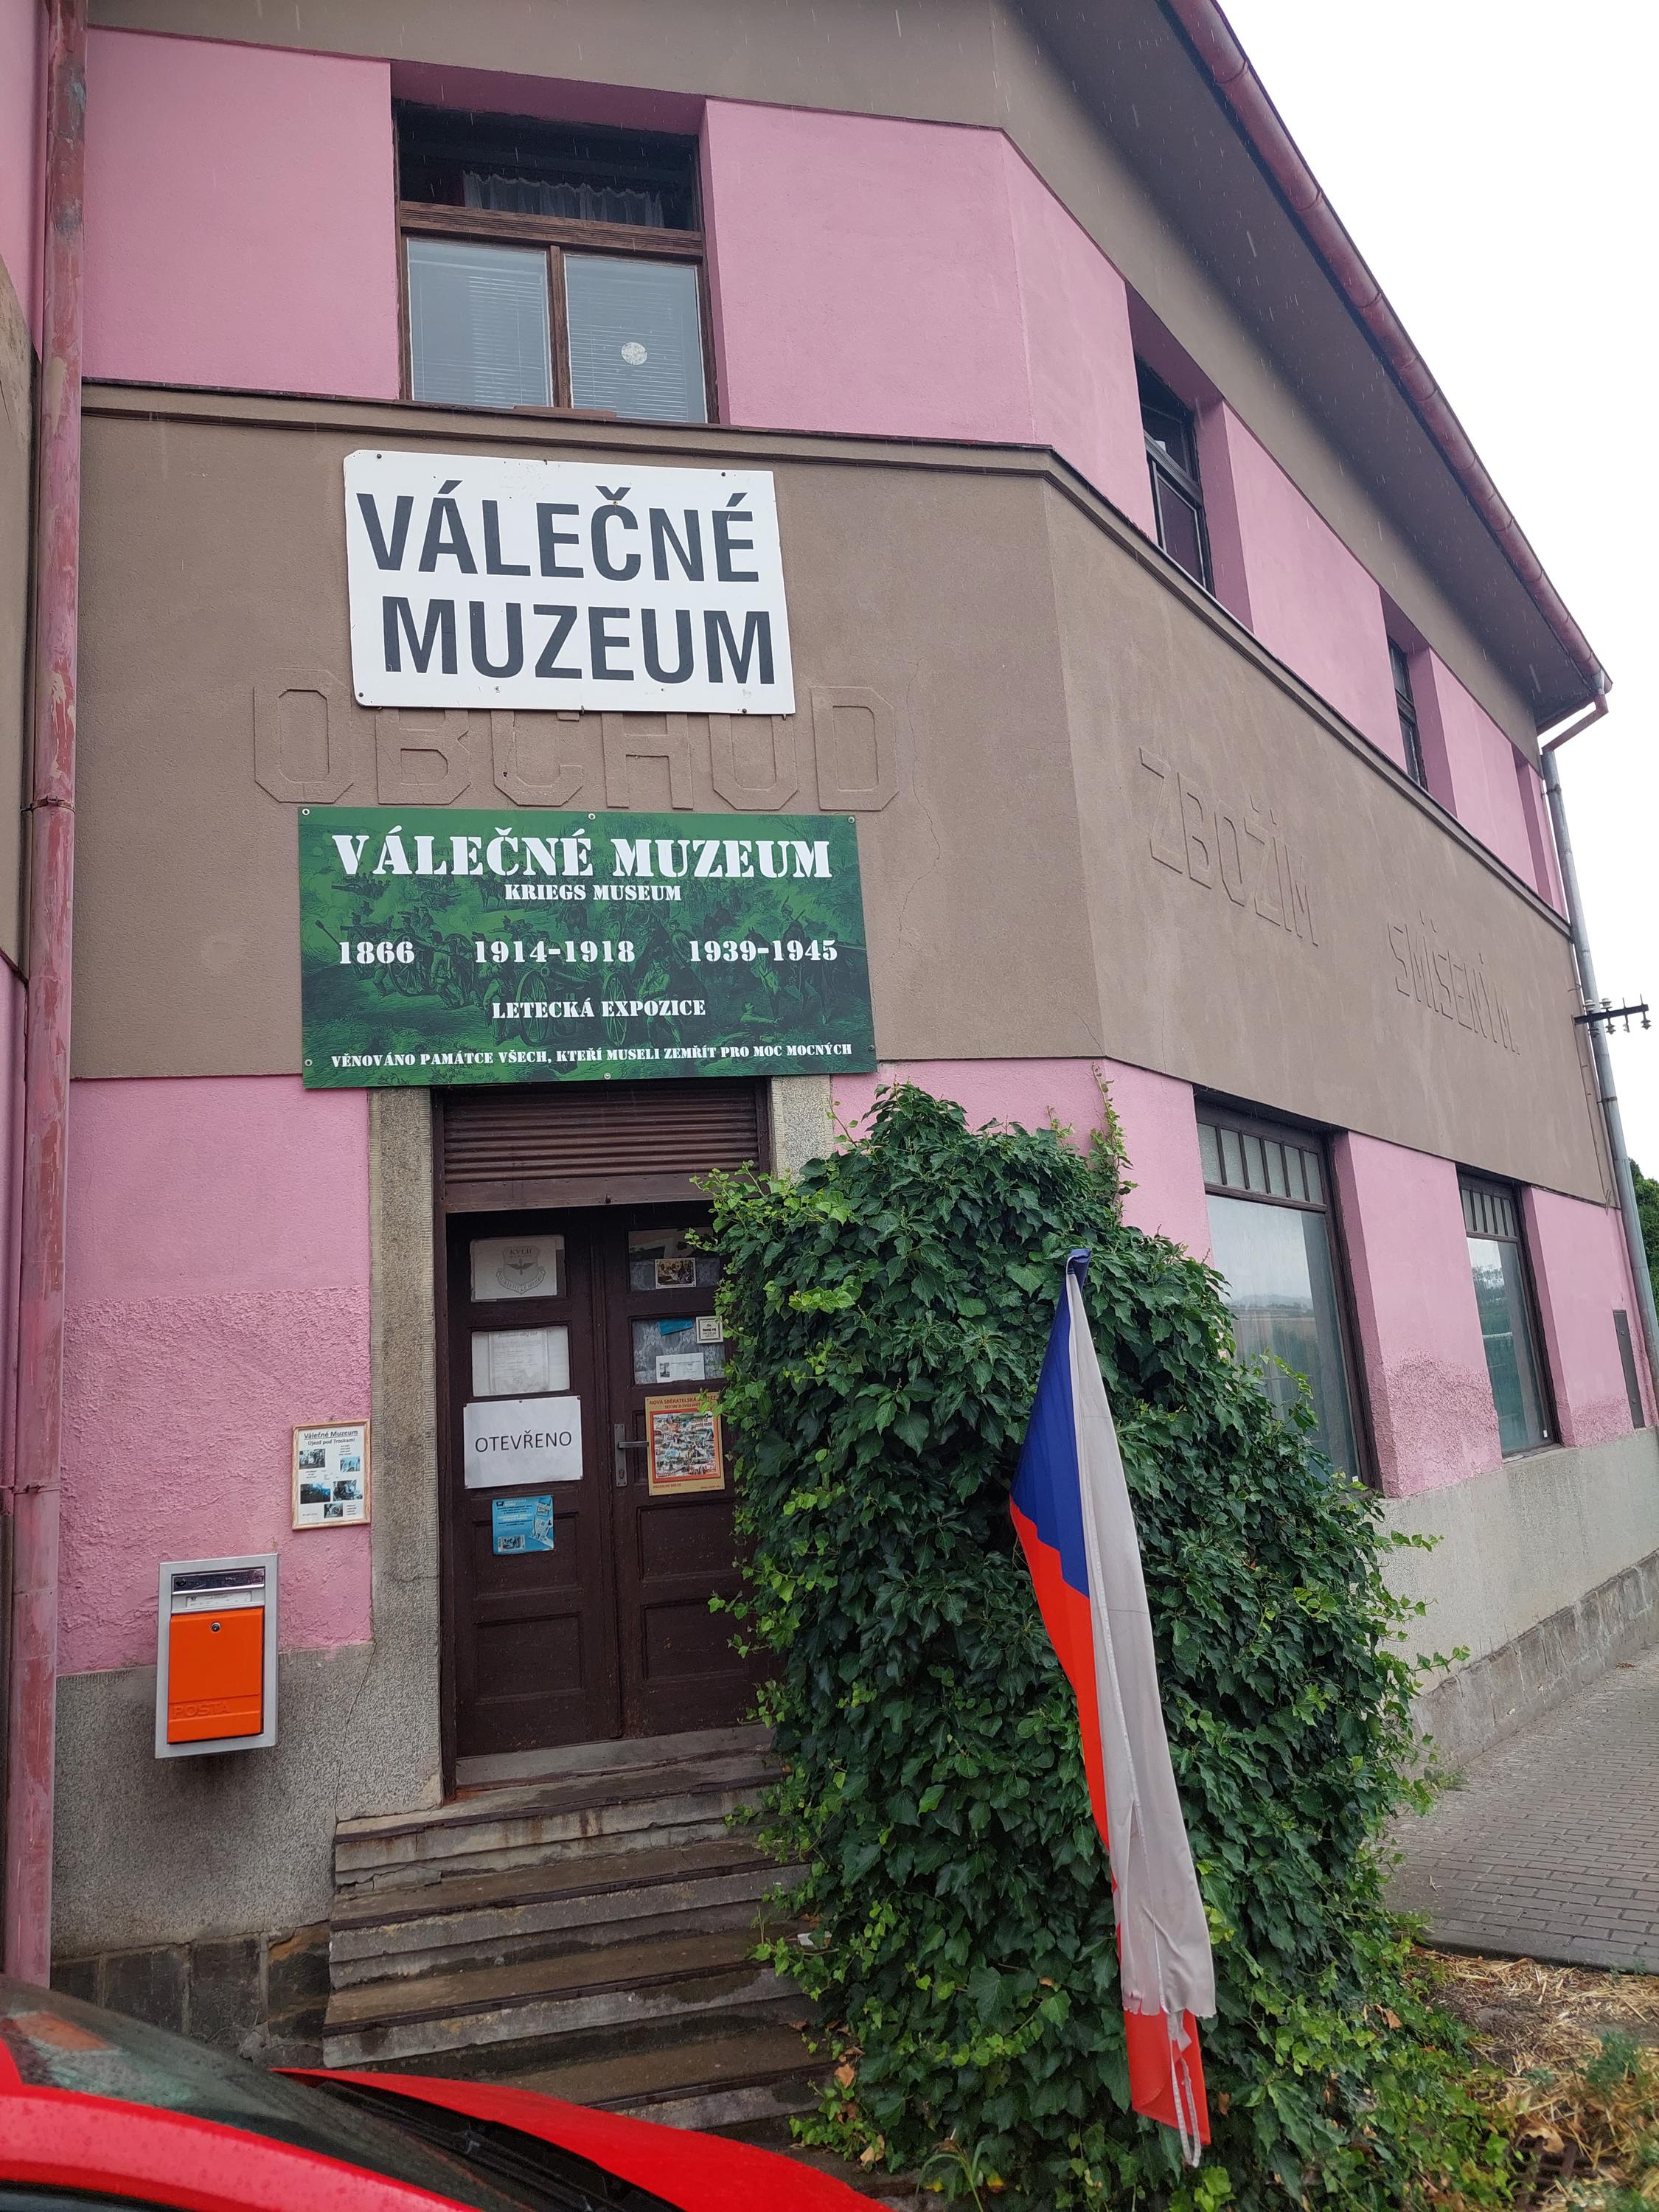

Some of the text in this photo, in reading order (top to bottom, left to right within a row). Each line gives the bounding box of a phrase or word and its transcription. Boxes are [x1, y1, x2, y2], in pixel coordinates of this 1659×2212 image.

[357, 480, 759, 582] VÁLEČNÉ
[383, 596, 775, 684] MUZEUM
[332, 825, 832, 878] VÁLEČNÉ MUZEUM
[504, 884, 682, 901] KRIEGS MUSEUM
[338, 941, 415, 964] 1866
[474, 940, 636, 963] 1914-1918
[689, 939, 838, 962] 1939-1945
[493, 997, 706, 1019] LETECKÁ EXPOZICE
[331, 1043, 852, 1067] VĚNOVÁNO PAMÁTCE VŠECH, KTEŘÍ MUSELI ZEMŘÍT PRO MOC MOCNÝCH
[475, 1429, 571, 1452] OTEVŘENO
